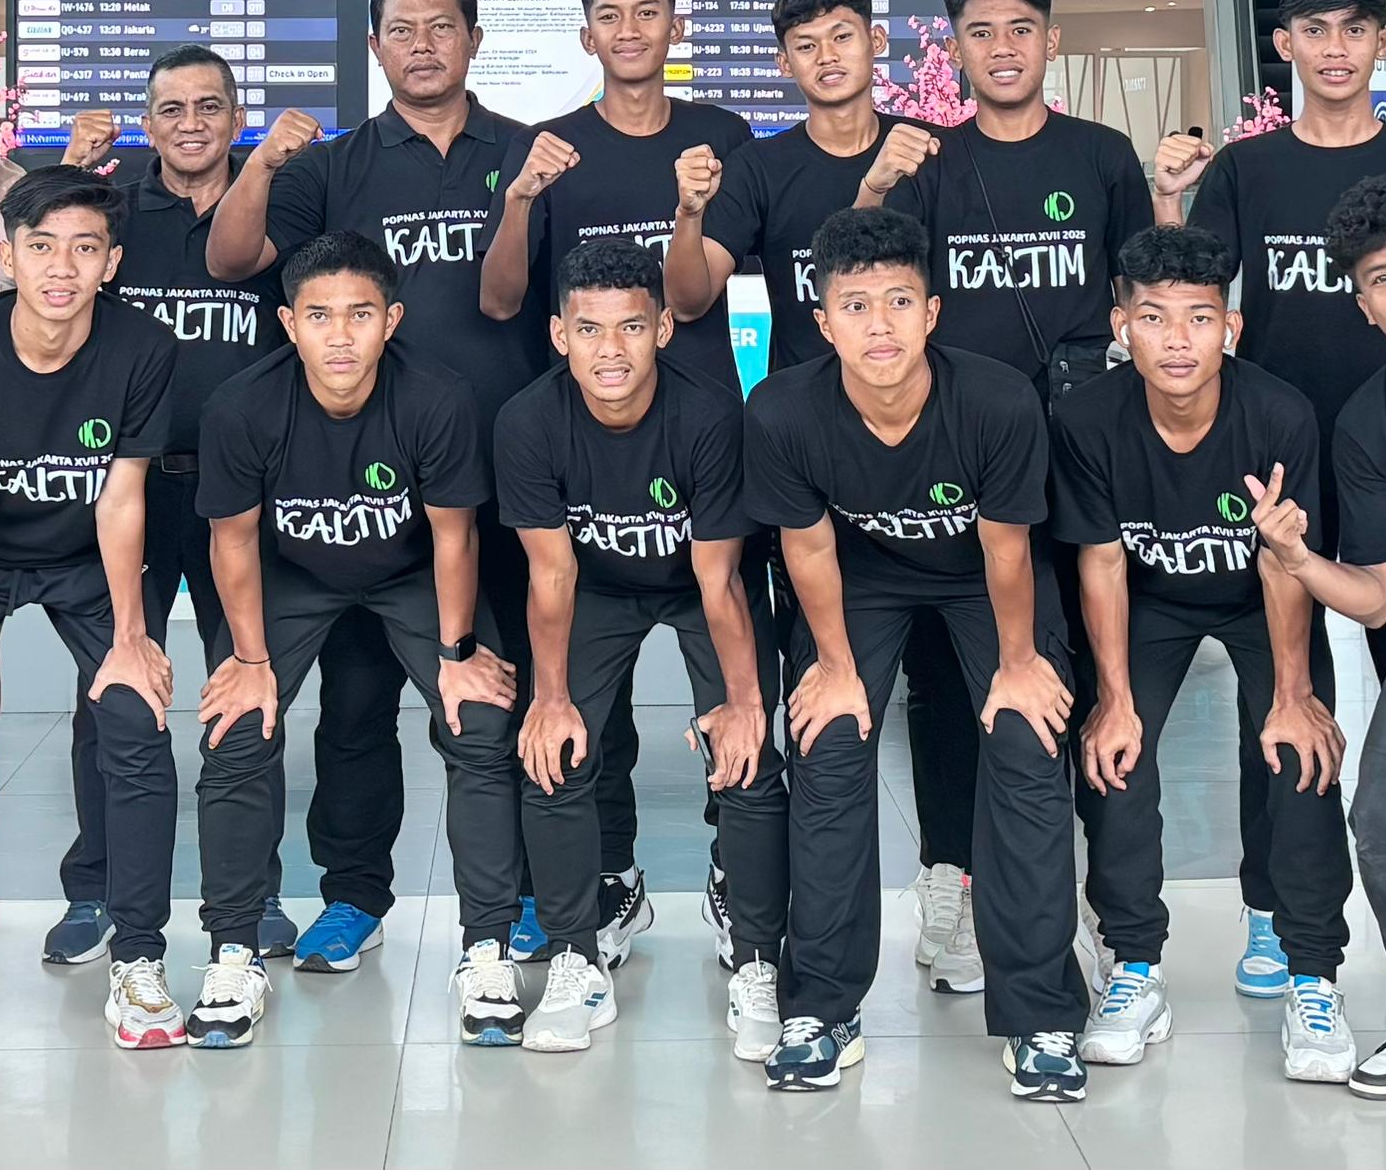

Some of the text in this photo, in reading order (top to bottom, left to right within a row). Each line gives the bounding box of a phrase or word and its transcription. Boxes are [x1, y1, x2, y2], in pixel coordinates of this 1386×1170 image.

[382, 209, 489, 226] POPNAS JAKARTA XV
[578, 221, 666, 237] POPNAS JAKARTA
[384, 223, 487, 266] KALT
[947, 233, 990, 245] POPNAS
[1038, 231, 1061, 242] XVII
[1062, 230, 1086, 240] 2025
[1264, 235, 1303, 244] POPNAS
[948, 243, 1086, 289] KALTIM
[119, 286, 260, 303] POPNAS JAKARTA XVII 2025
[121, 299, 257, 346] ALTIM
[74, 456, 99, 467] XVII
[275, 498, 320, 509] POPNAS
[276, 496, 412, 546] KALTIM
[594, 513, 644, 524] JAKARTA
[1160, 526, 1211, 540] JAKARTA
[1212, 525, 1234, 537] XVII
